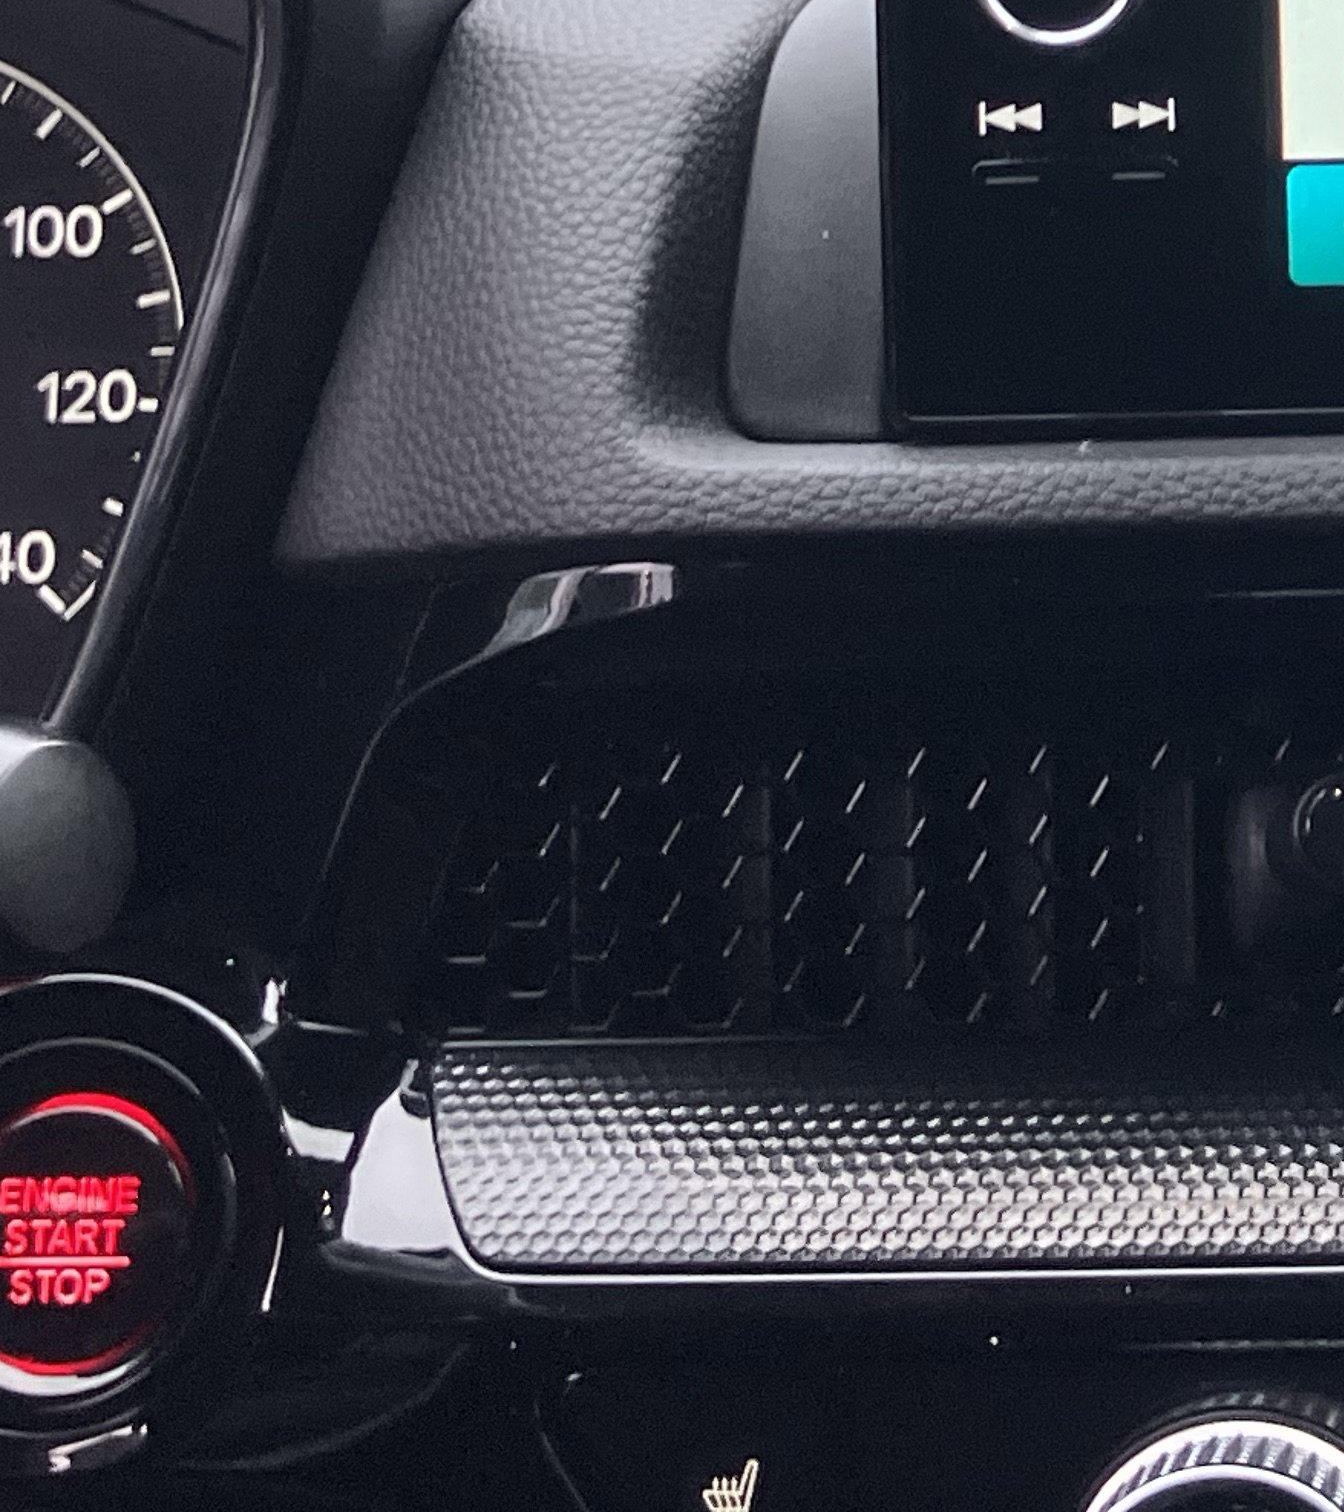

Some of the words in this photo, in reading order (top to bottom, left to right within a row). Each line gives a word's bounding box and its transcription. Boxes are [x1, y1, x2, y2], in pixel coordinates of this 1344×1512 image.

[4, 201, 103, 258] 100
[37, 369, 137, 424] 120
[0, 1175, 141, 1214] ENGINE
[3, 1218, 126, 1256] START
[8, 1269, 111, 1305] STOP
